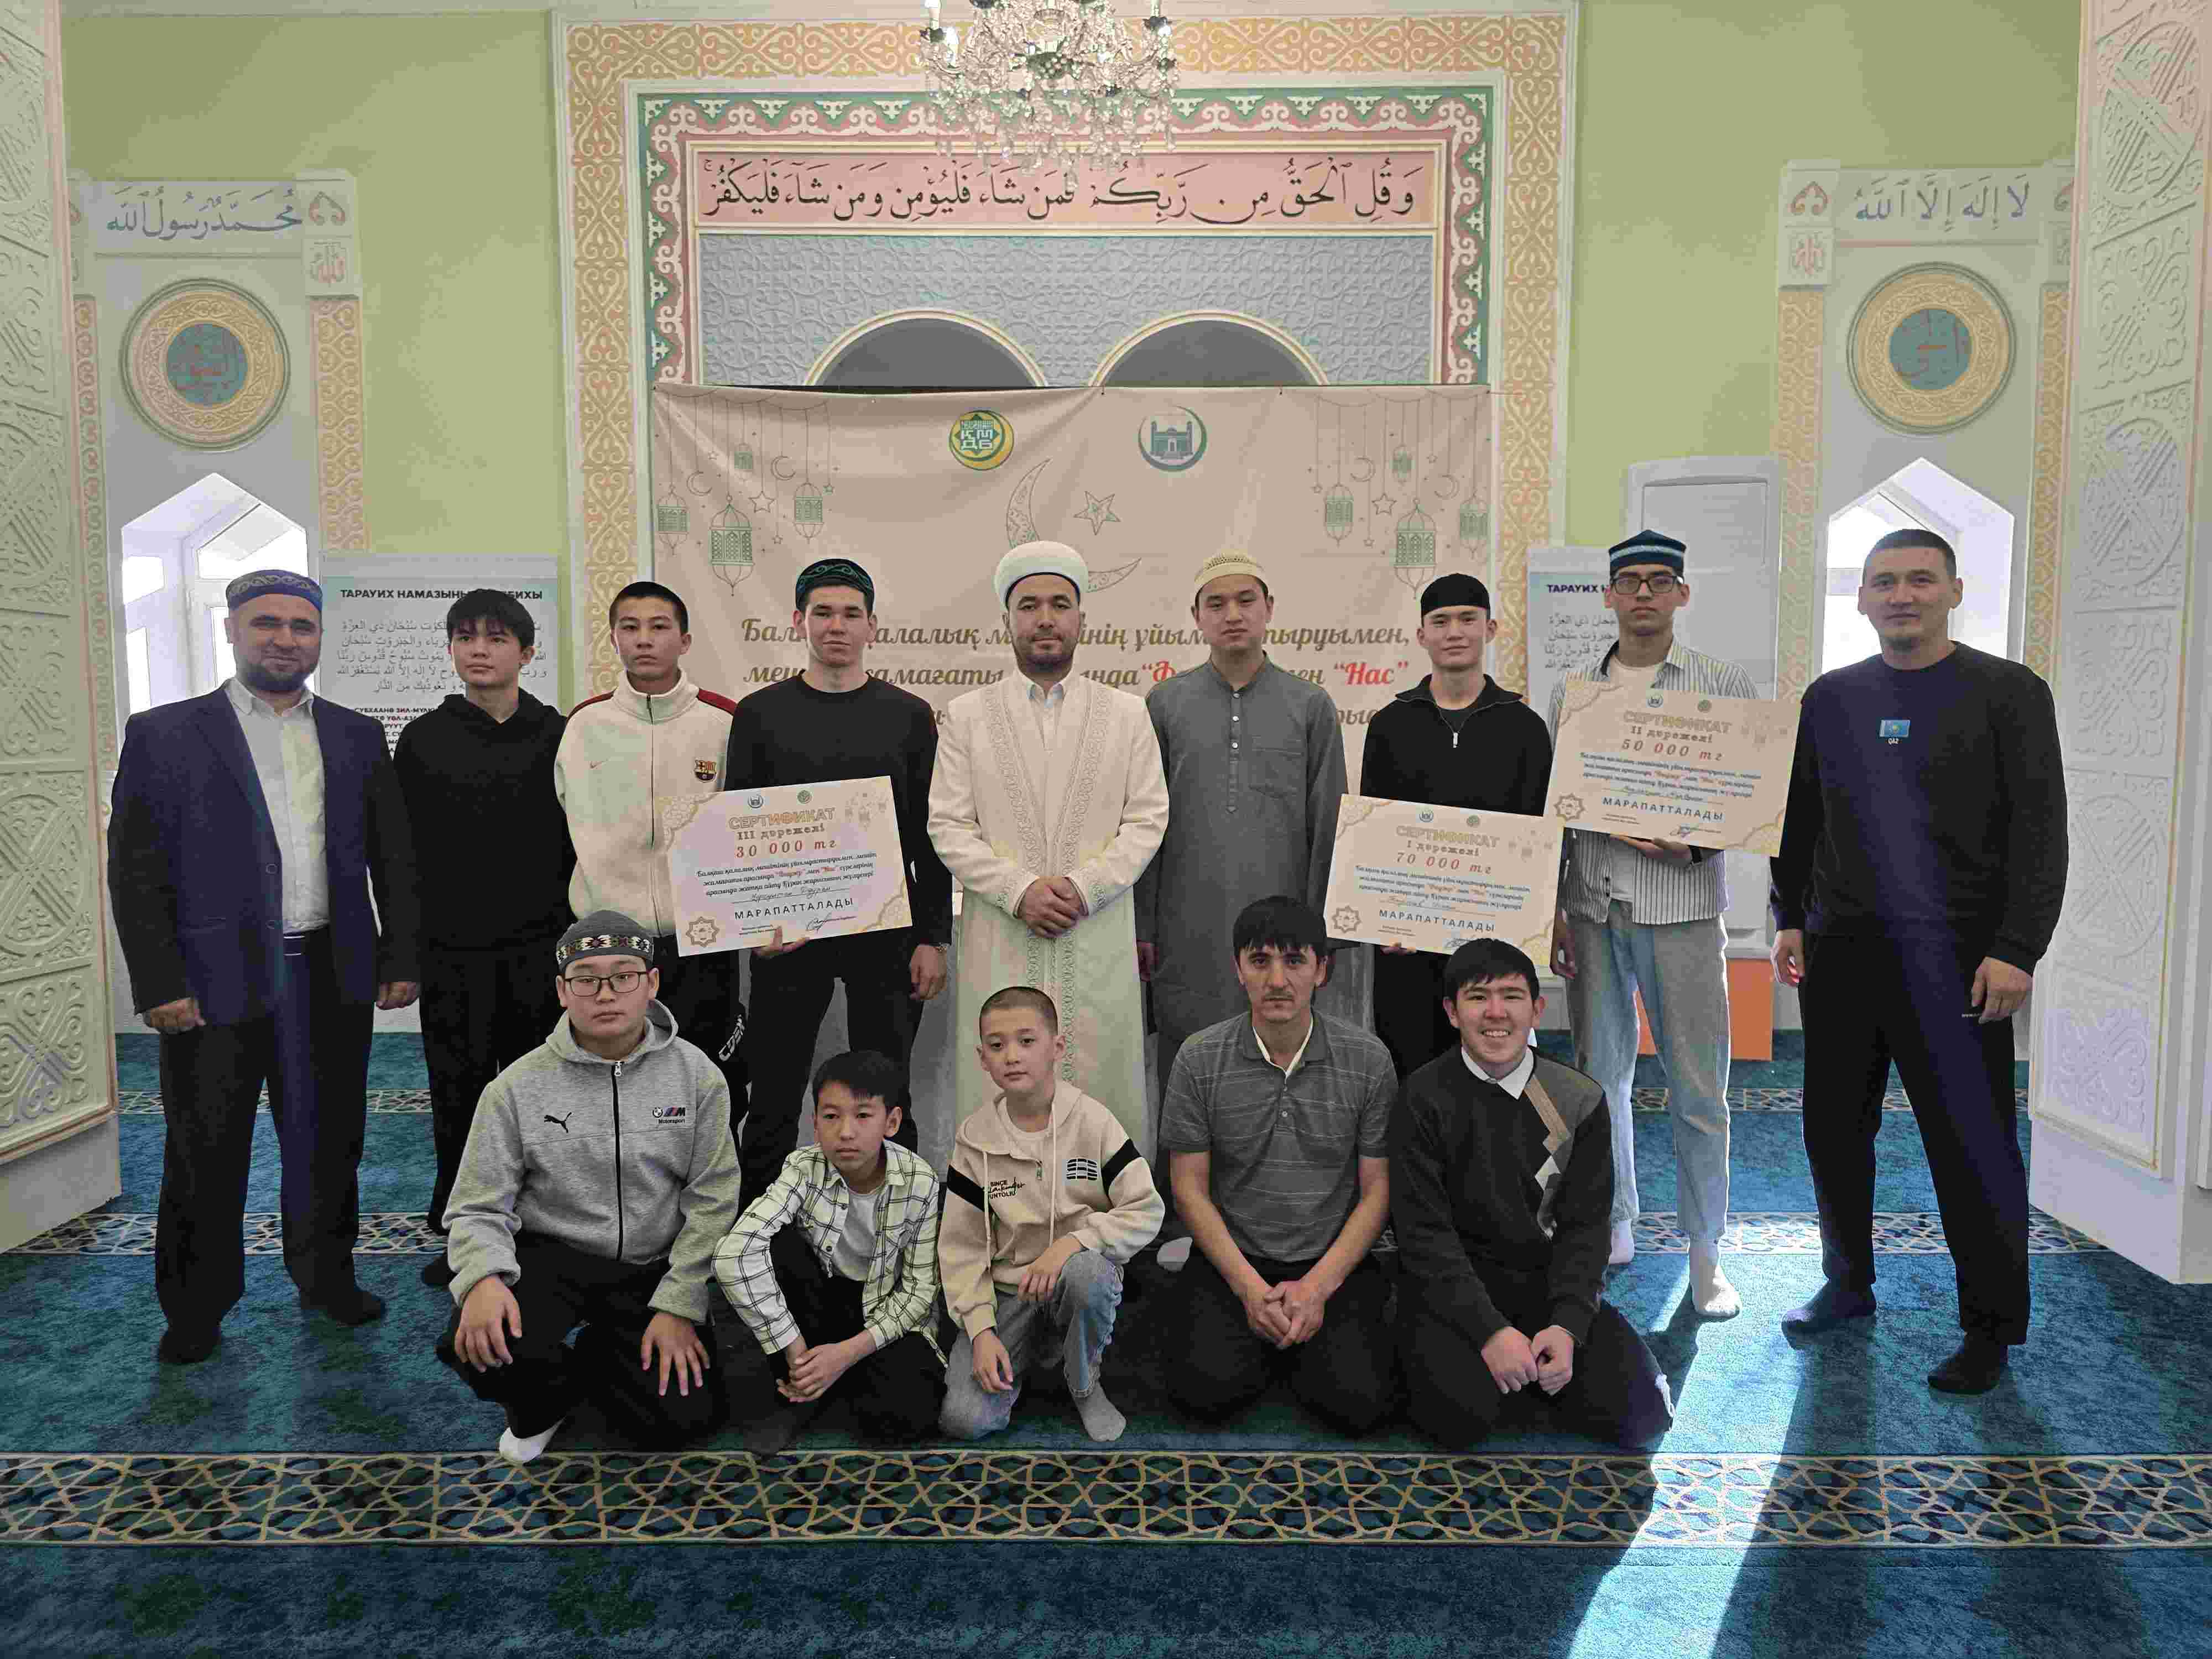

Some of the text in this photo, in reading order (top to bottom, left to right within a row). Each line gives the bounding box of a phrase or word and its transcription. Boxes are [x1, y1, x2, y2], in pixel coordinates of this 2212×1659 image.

[341, 589, 394, 598] ТАРАУИХ
[1547, 584, 1598, 593] ТАРАУИХ
[865, 667, 1005, 686] амағаты
[728, 807, 836, 830] СЕРТИФИКАТ
[1602, 797, 1723, 822] МАРАПАТТАЛАДЫ
[769, 840, 803, 854] 000
[734, 897, 853, 921] МАРАПАТТАЛАДЫ
[1379, 909, 1495, 932] МАРАПАТТАЛАДЫ
